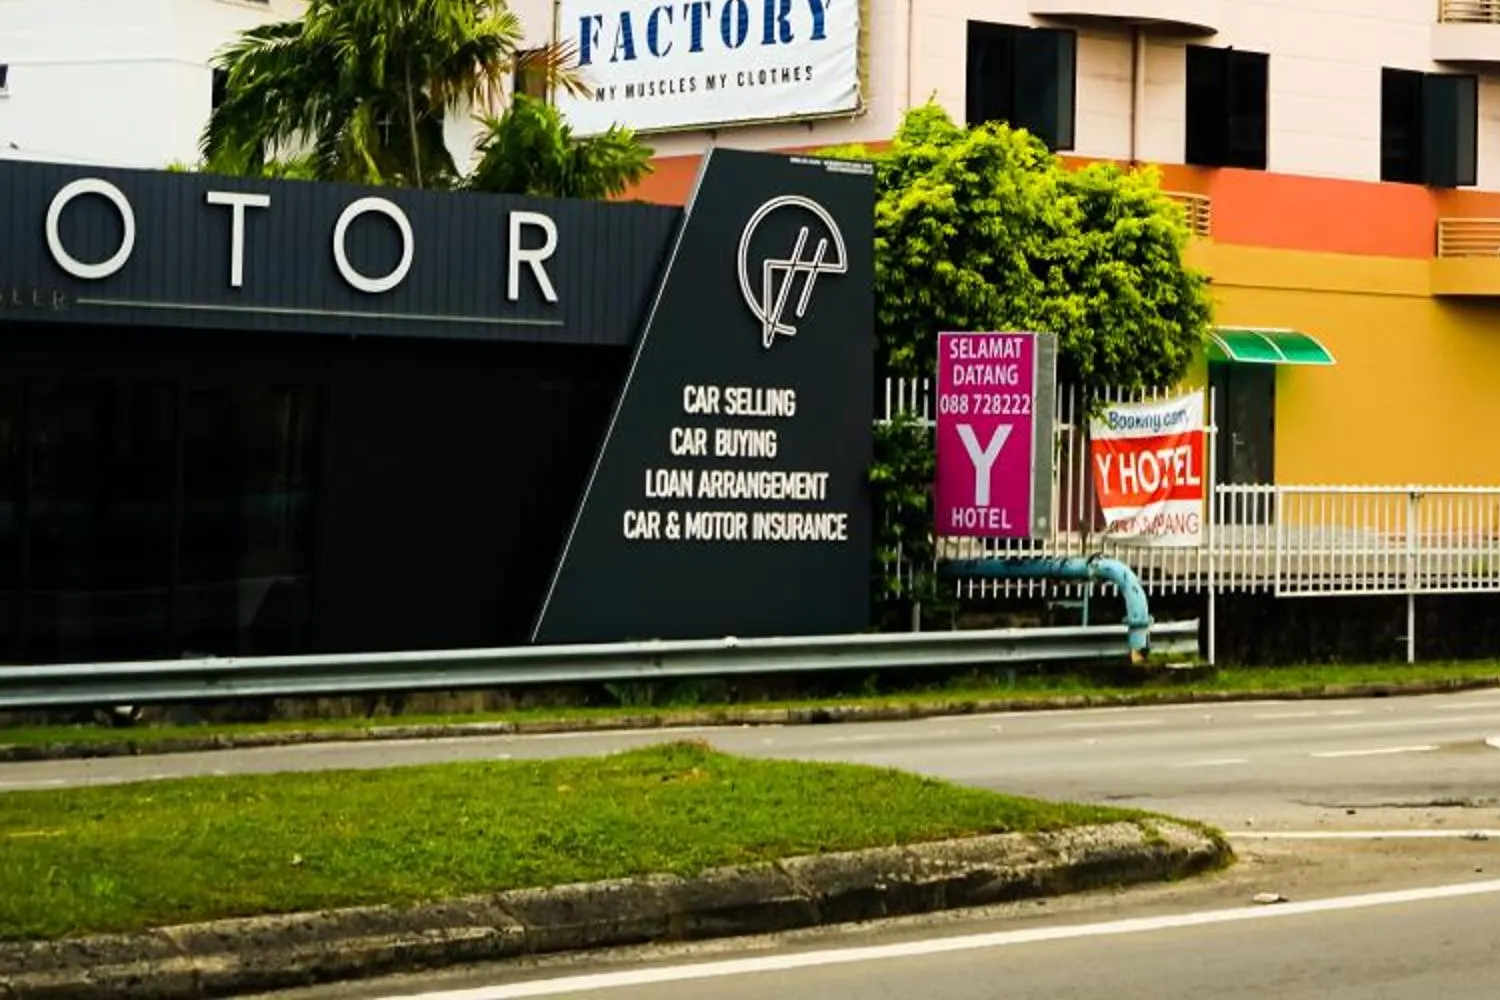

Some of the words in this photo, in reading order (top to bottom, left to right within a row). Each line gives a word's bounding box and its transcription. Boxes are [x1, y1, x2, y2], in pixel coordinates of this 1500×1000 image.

[595, 86, 617, 102] MY
[625, 76, 697, 99] MUSCLES
[705, 73, 728, 90] MY
[737, 65, 814, 87] CLOTHES
[0, 287, 68, 311] LER
[950, 337, 1023, 359] SELAMAT
[953, 364, 1019, 386] DATANG
[683, 385, 720, 414] CAR
[724, 387, 797, 417] SELLING
[940, 394, 968, 415] 088
[973, 394, 1031, 415] 728222
[670, 427, 707, 456] CAR
[715, 428, 777, 458] BUYING
[955, 423, 1014, 507] Y
[1095, 452, 1112, 496] Y
[1118, 444, 1201, 495] HOTEL
[645, 469, 694, 499] LOAN
[697, 470, 829, 500] ARRANGEMENT
[623, 510, 661, 540] CAR
[665, 511, 681, 540] &
[685, 511, 748, 540] MOTOR
[752, 512, 848, 541] INSURANCE
[951, 507, 1012, 529] HOTEL
